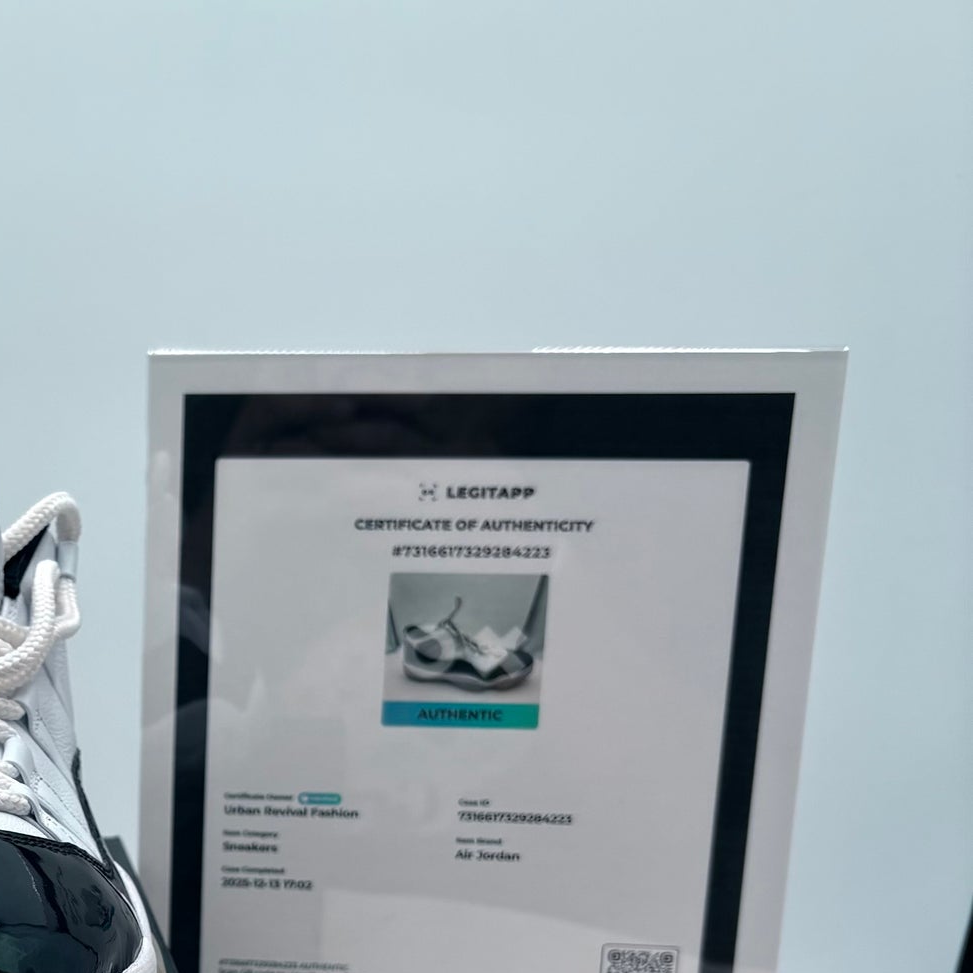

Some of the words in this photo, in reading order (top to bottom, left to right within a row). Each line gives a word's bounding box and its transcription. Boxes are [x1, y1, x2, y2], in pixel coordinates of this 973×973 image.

[446, 486, 536, 500] LEGITAPP
[354, 518, 452, 531] CERTIFICATE
[455, 519, 477, 532] OF
[480, 520, 594, 533] AUTHENTICITY
[417, 708, 503, 721] AUTHENTIC
[224, 806, 261, 816] Urban
[264, 806, 308, 817] Revival
[311, 807, 359, 819] Fashion
[223, 841, 278, 853] Sneakers
[455, 850, 473, 861] Air
[476, 850, 521, 862] Jordan
